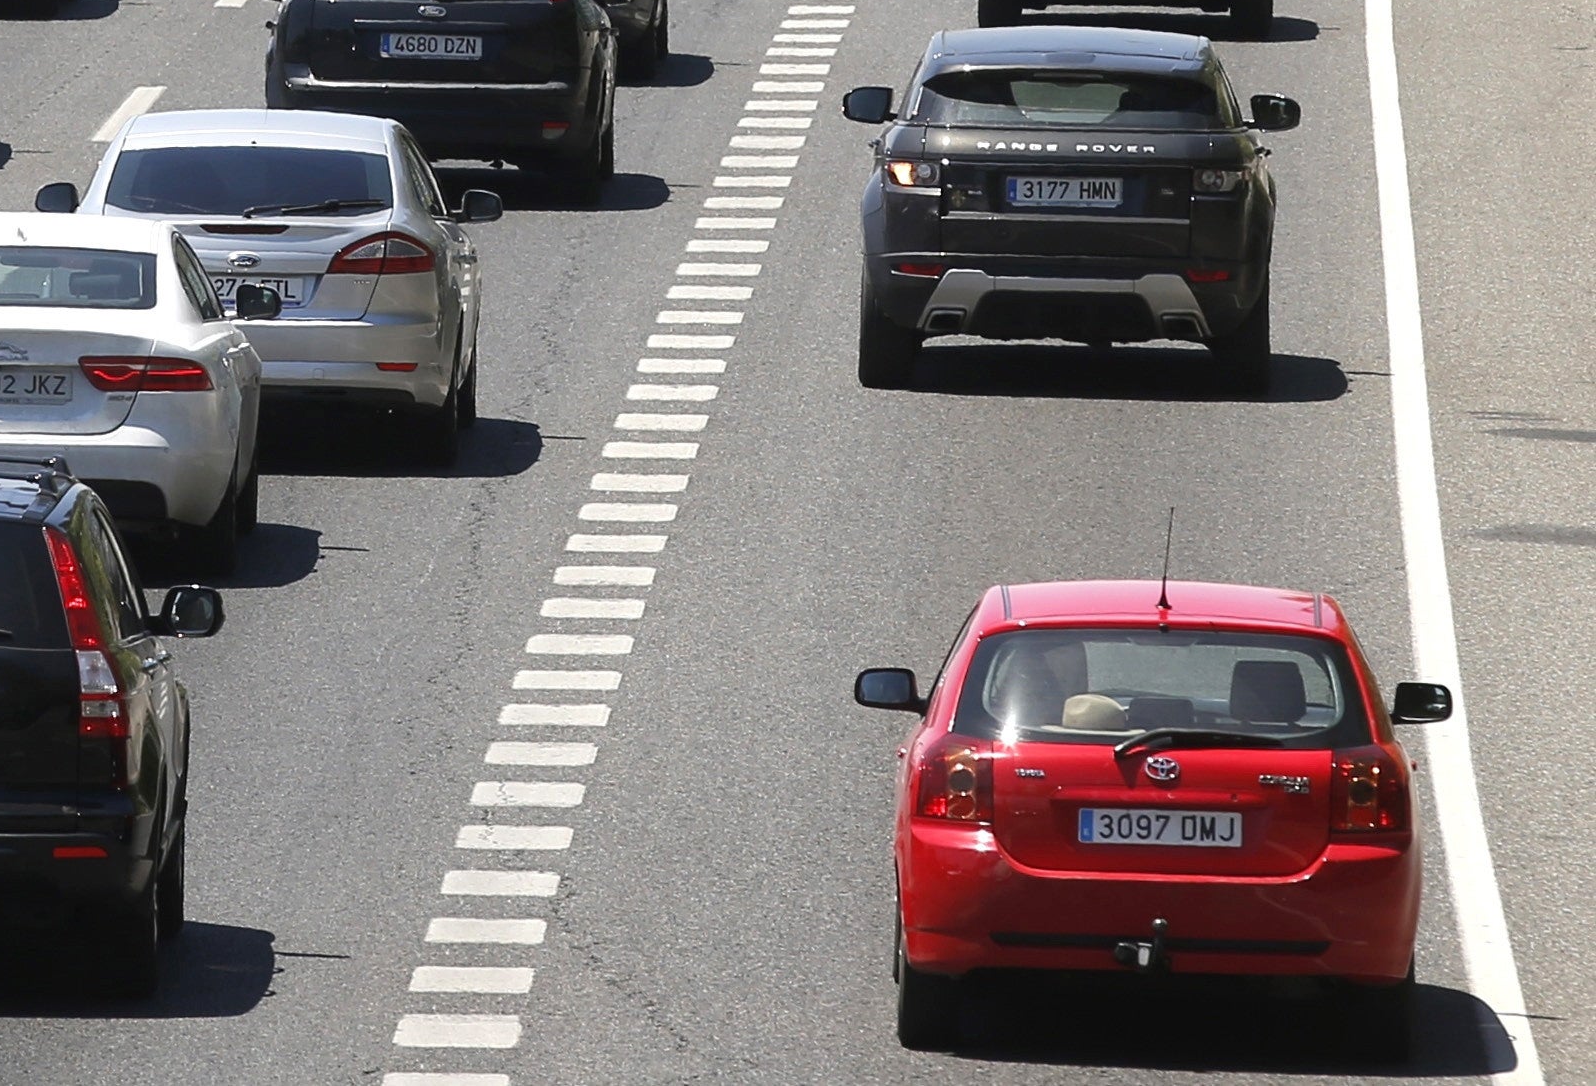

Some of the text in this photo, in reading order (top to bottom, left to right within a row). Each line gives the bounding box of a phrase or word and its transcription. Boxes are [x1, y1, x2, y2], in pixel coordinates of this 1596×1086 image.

[395, 38, 476, 54] 4680 DZN
[977, 141, 1157, 153] RANGE ROVER
[1022, 181, 1116, 200] 3177 HMN
[24, 375, 66, 396] JKZ
[1015, 768, 1045, 777] TOYOTA
[1098, 814, 1236, 842] 3097 DMJ
